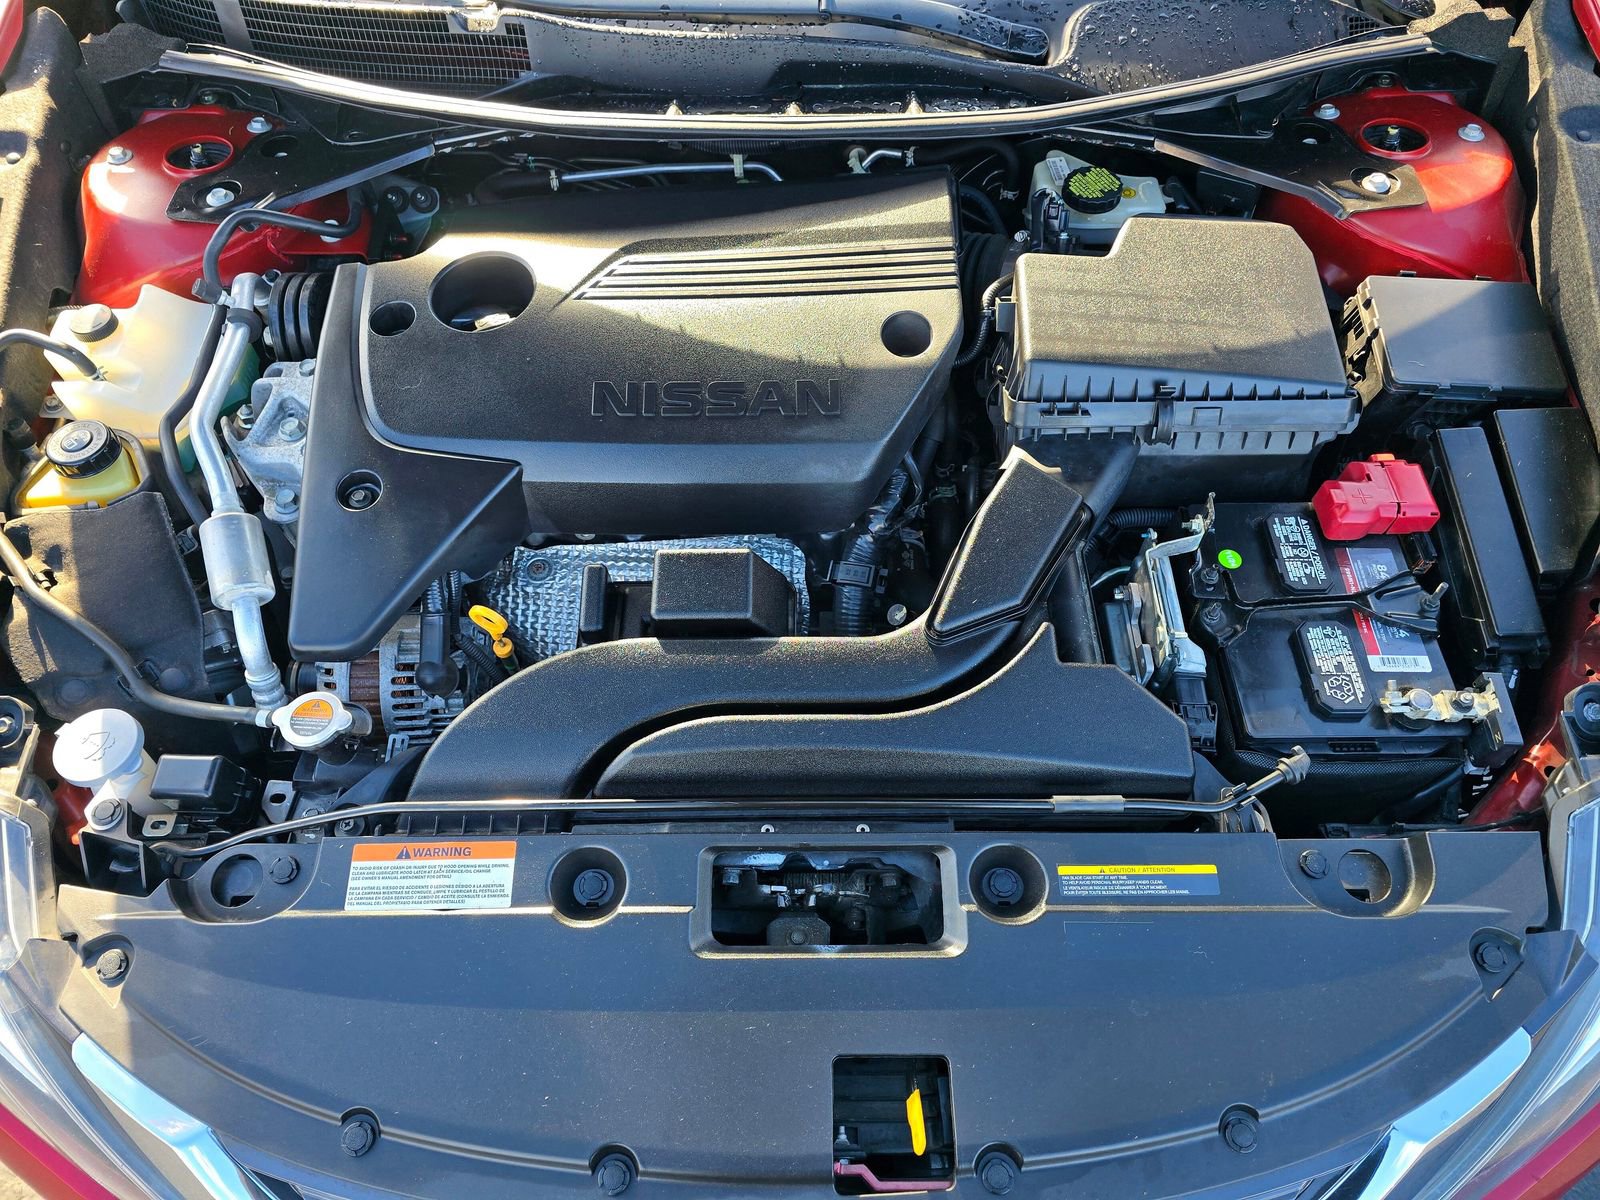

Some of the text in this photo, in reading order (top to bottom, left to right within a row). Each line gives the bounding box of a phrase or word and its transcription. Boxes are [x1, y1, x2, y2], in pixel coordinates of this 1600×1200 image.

[591, 379, 841, 417] NISSAN
[1302, 526, 1316, 550] DANGER
[1313, 556, 1327, 579] POISON
[1377, 564, 1390, 580] 84
[413, 847, 471, 857] WARNING
